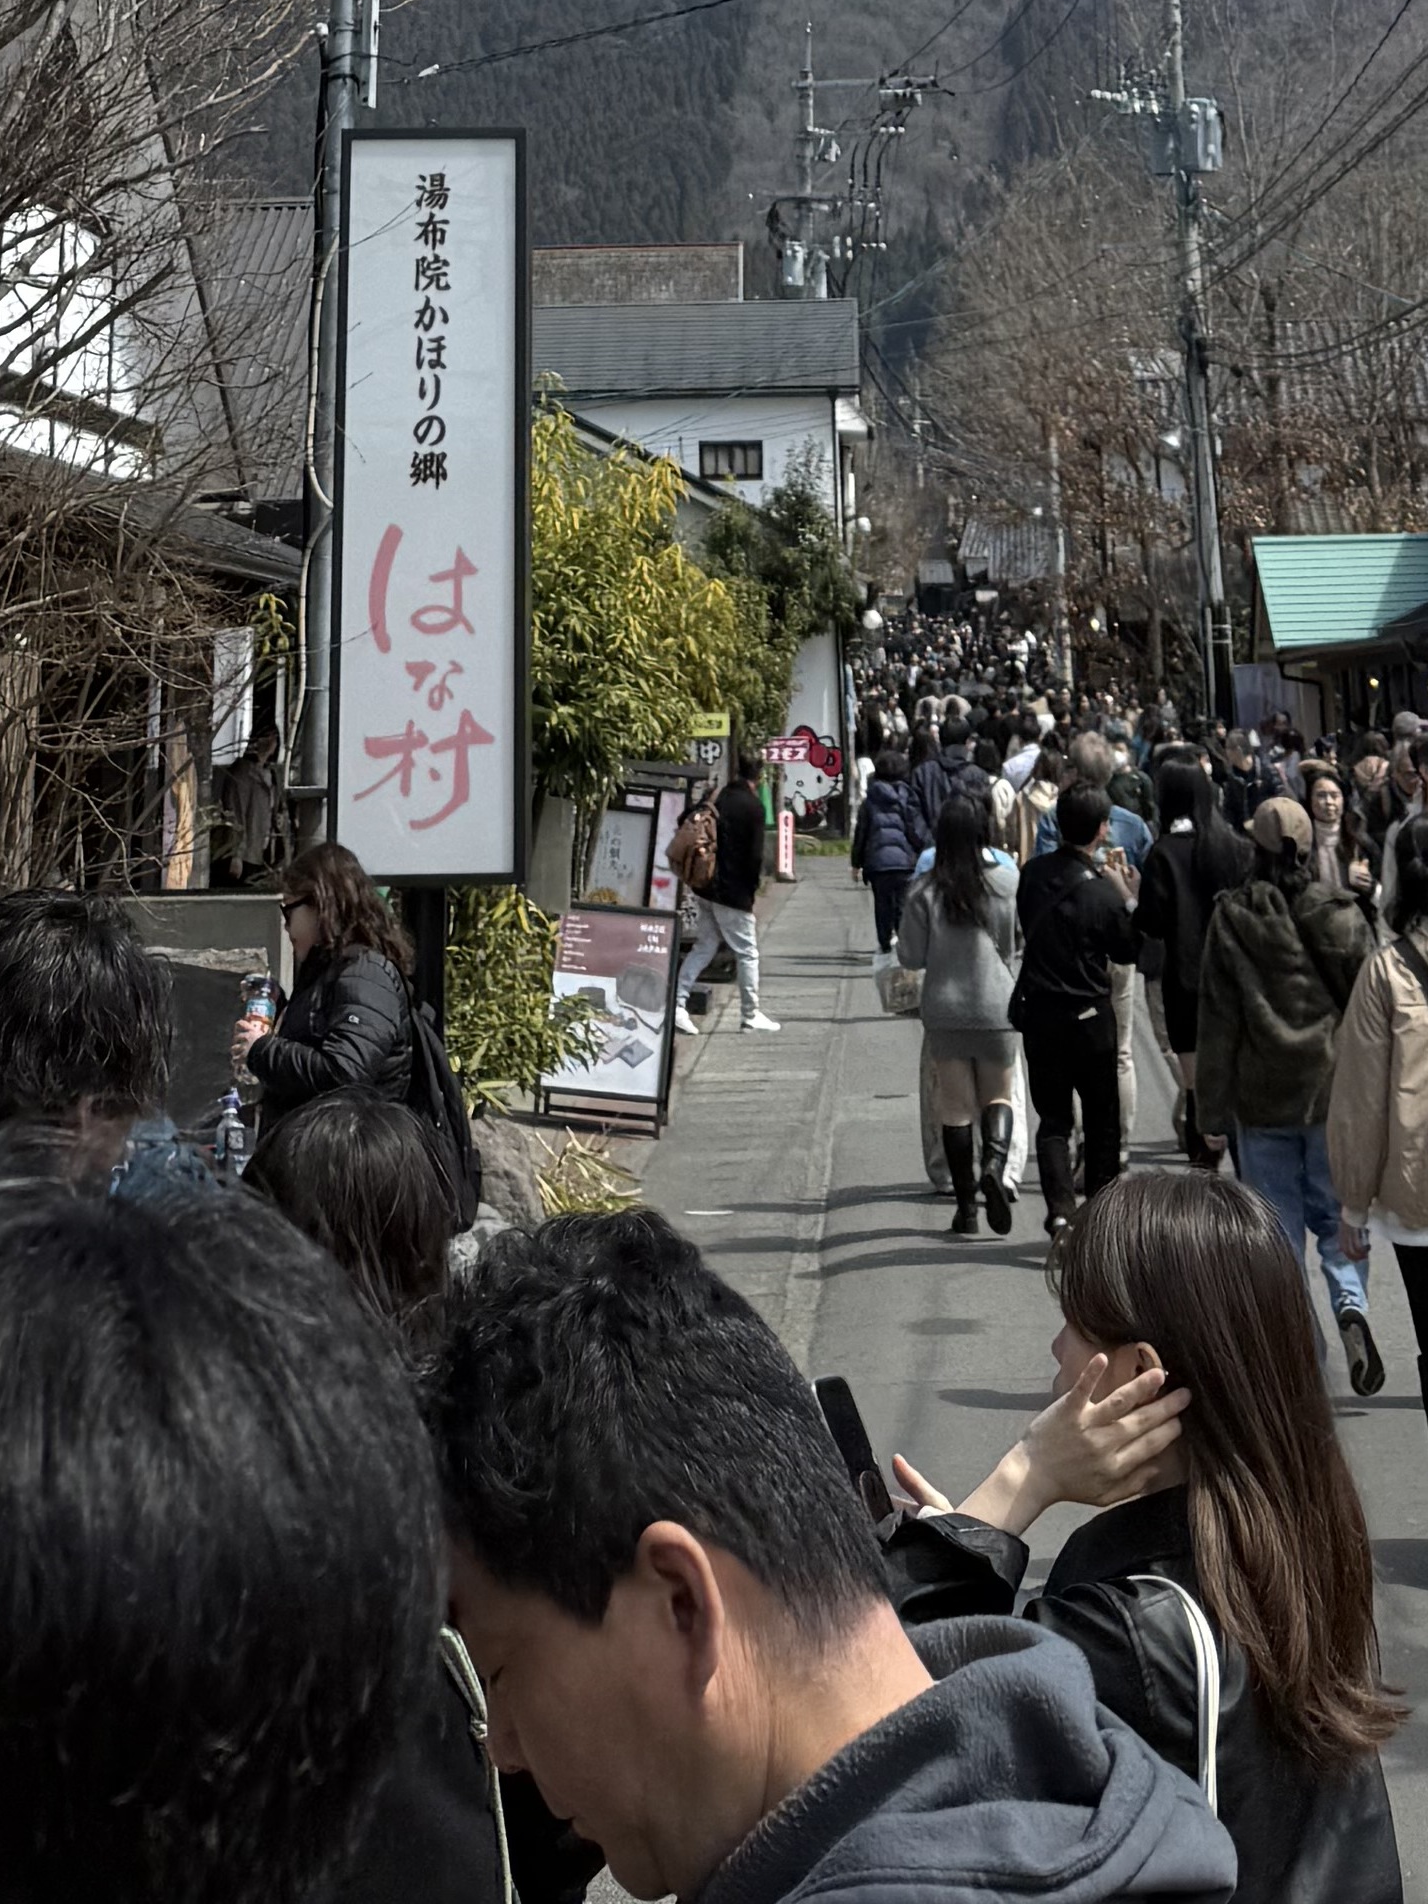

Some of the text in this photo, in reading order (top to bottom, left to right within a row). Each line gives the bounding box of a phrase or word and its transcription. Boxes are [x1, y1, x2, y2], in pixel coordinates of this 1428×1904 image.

[410, 171, 452, 490] 湯布院かほりの郷
[353, 523, 495, 830] はな村
